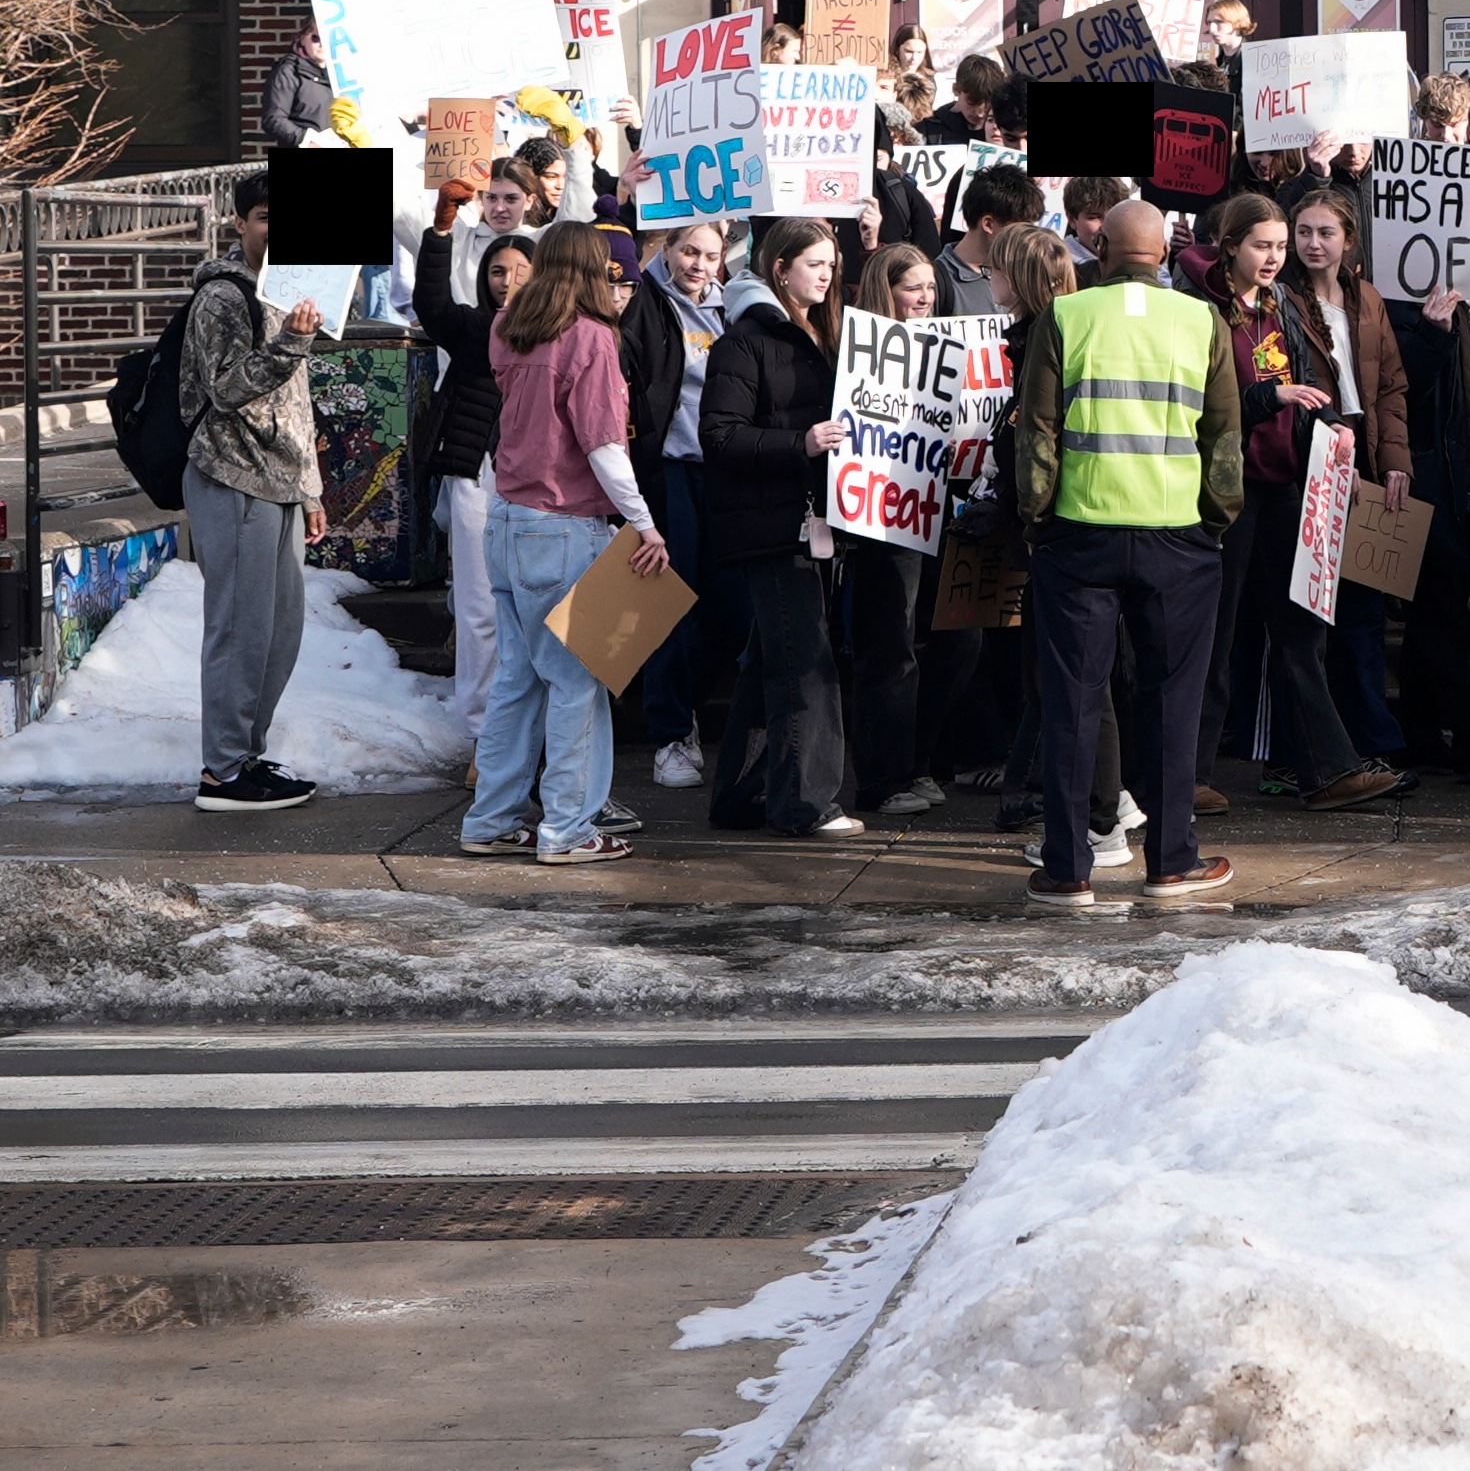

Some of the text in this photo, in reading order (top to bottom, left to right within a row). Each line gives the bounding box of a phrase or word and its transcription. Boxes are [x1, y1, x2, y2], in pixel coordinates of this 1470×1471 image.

[569, 8, 615, 40] ICE
[655, 14, 754, 89] LOVE
[803, 32, 887, 66] PATRIOTISM
[1004, 27, 1069, 79] KEEP
[643, 69, 761, 147] MELTS
[776, 70, 869, 102] LEARNED
[1255, 81, 1312, 124] MELT
[428, 108, 478, 132] LOVE
[806, 106, 859, 131] YOU
[426, 137, 480, 158] MELTS
[428, 159, 469, 179] ICE
[1373, 139, 1404, 175] NO
[640, 137, 752, 221] ICE
[1373, 179, 1431, 223] HAS
[1439, 182, 1463, 228] A
[912, 319, 967, 341] ON'T
[847, 316, 966, 403] HATE
[851, 378, 953, 433] doesn't make
[836, 461, 941, 543] Great
[1301, 475, 1321, 548] OUR
[1308, 437, 1340, 611] CLASSMATES
[1359, 499, 1411, 544] ICE
[1321, 452, 1352, 618] LIVE IN FEAR
[1354, 541, 1400, 581] OUT!
